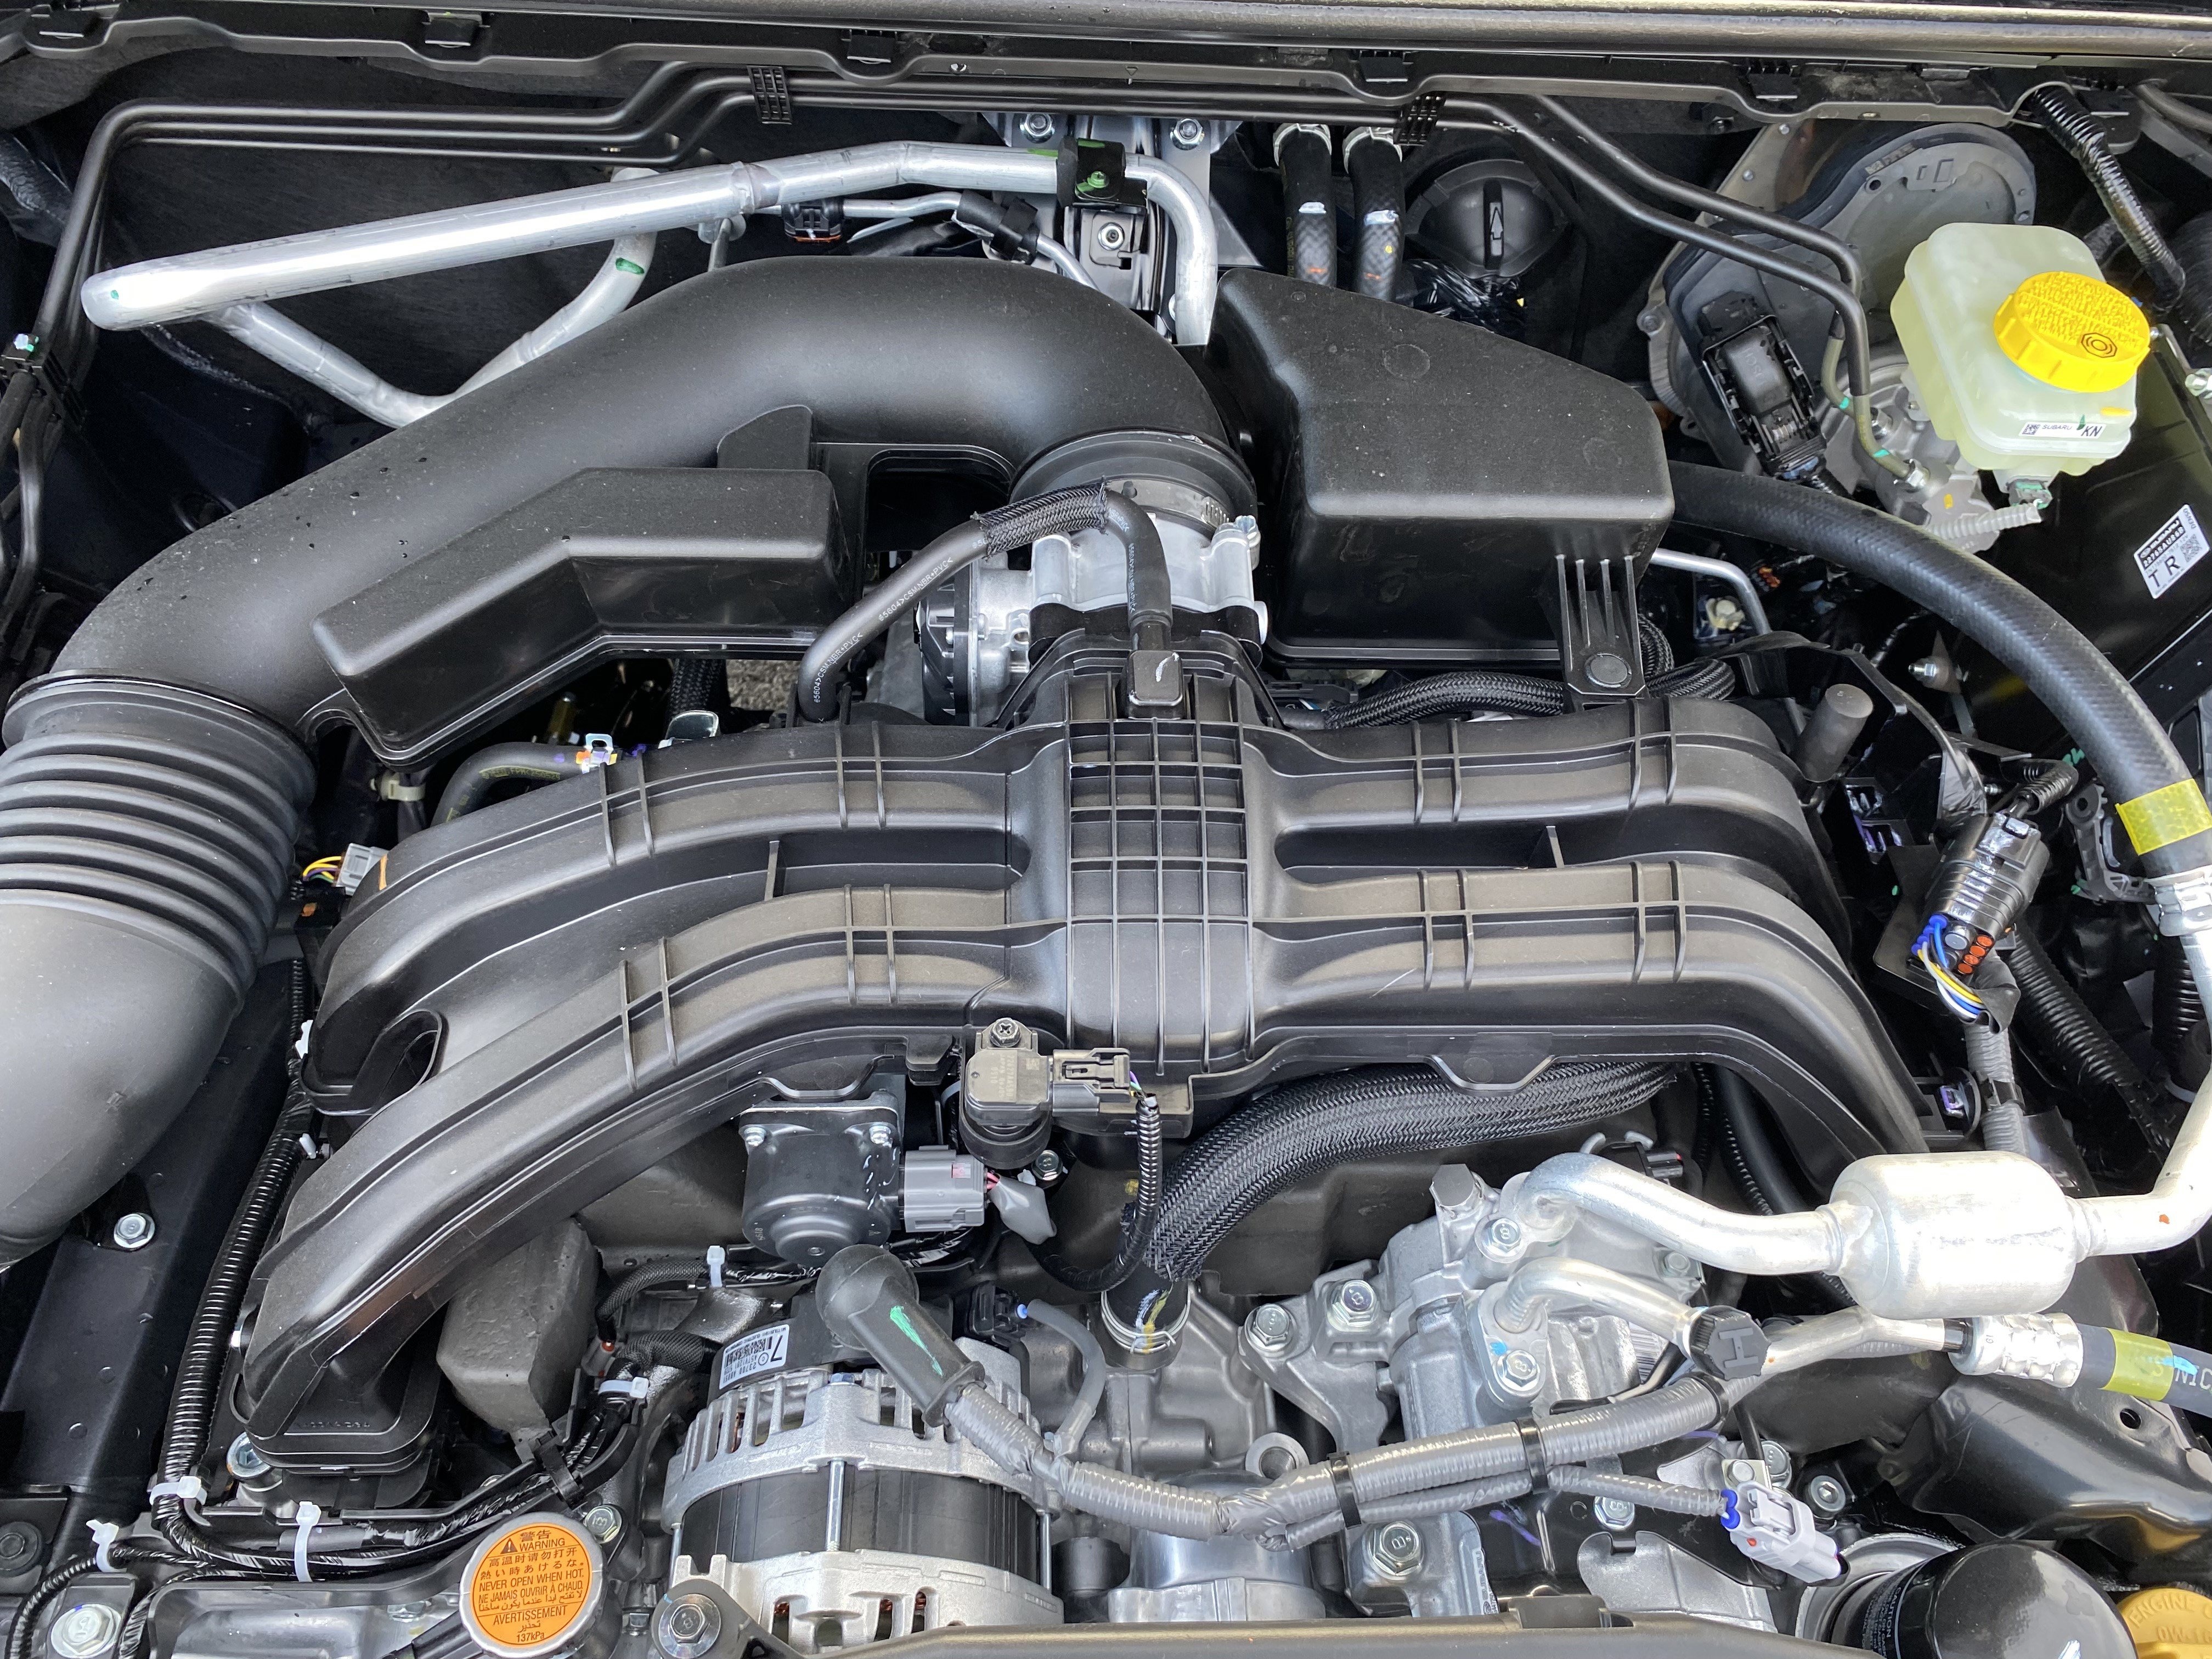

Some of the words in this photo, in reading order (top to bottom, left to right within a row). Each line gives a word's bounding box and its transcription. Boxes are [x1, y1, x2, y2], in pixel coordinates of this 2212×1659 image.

[2081, 426, 2102, 437] KN
[770, 1335, 783, 1362] 7
[1719, 1328, 1759, 1368] H
[520, 1530, 551, 1542] 警告
[520, 1538, 565, 1551] WARNING
[489, 1547, 577, 1567] 高温时请勿打开
[479, 1579, 507, 1592] NEVER
[511, 1575, 533, 1588] OPEN
[537, 1571, 562, 1583] WHEN
[566, 1568, 584, 1581] HOT.
[1476, 1550, 1488, 1600] SUBARU
[479, 1593, 488, 1604] NE
[490, 1590, 517, 1602] JAMAIS
[521, 1585, 548, 1598] OUVRIR
[550, 1582, 555, 1594] À
[558, 1581, 583, 1593] CHAUD.
[493, 1605, 568, 1626] AVERTISSEMENT
[1887, 1587, 1901, 1638] CAUTION
[2129, 1594, 2194, 1628] ENGINE
[516, 1631, 545, 1643] 137kPa
